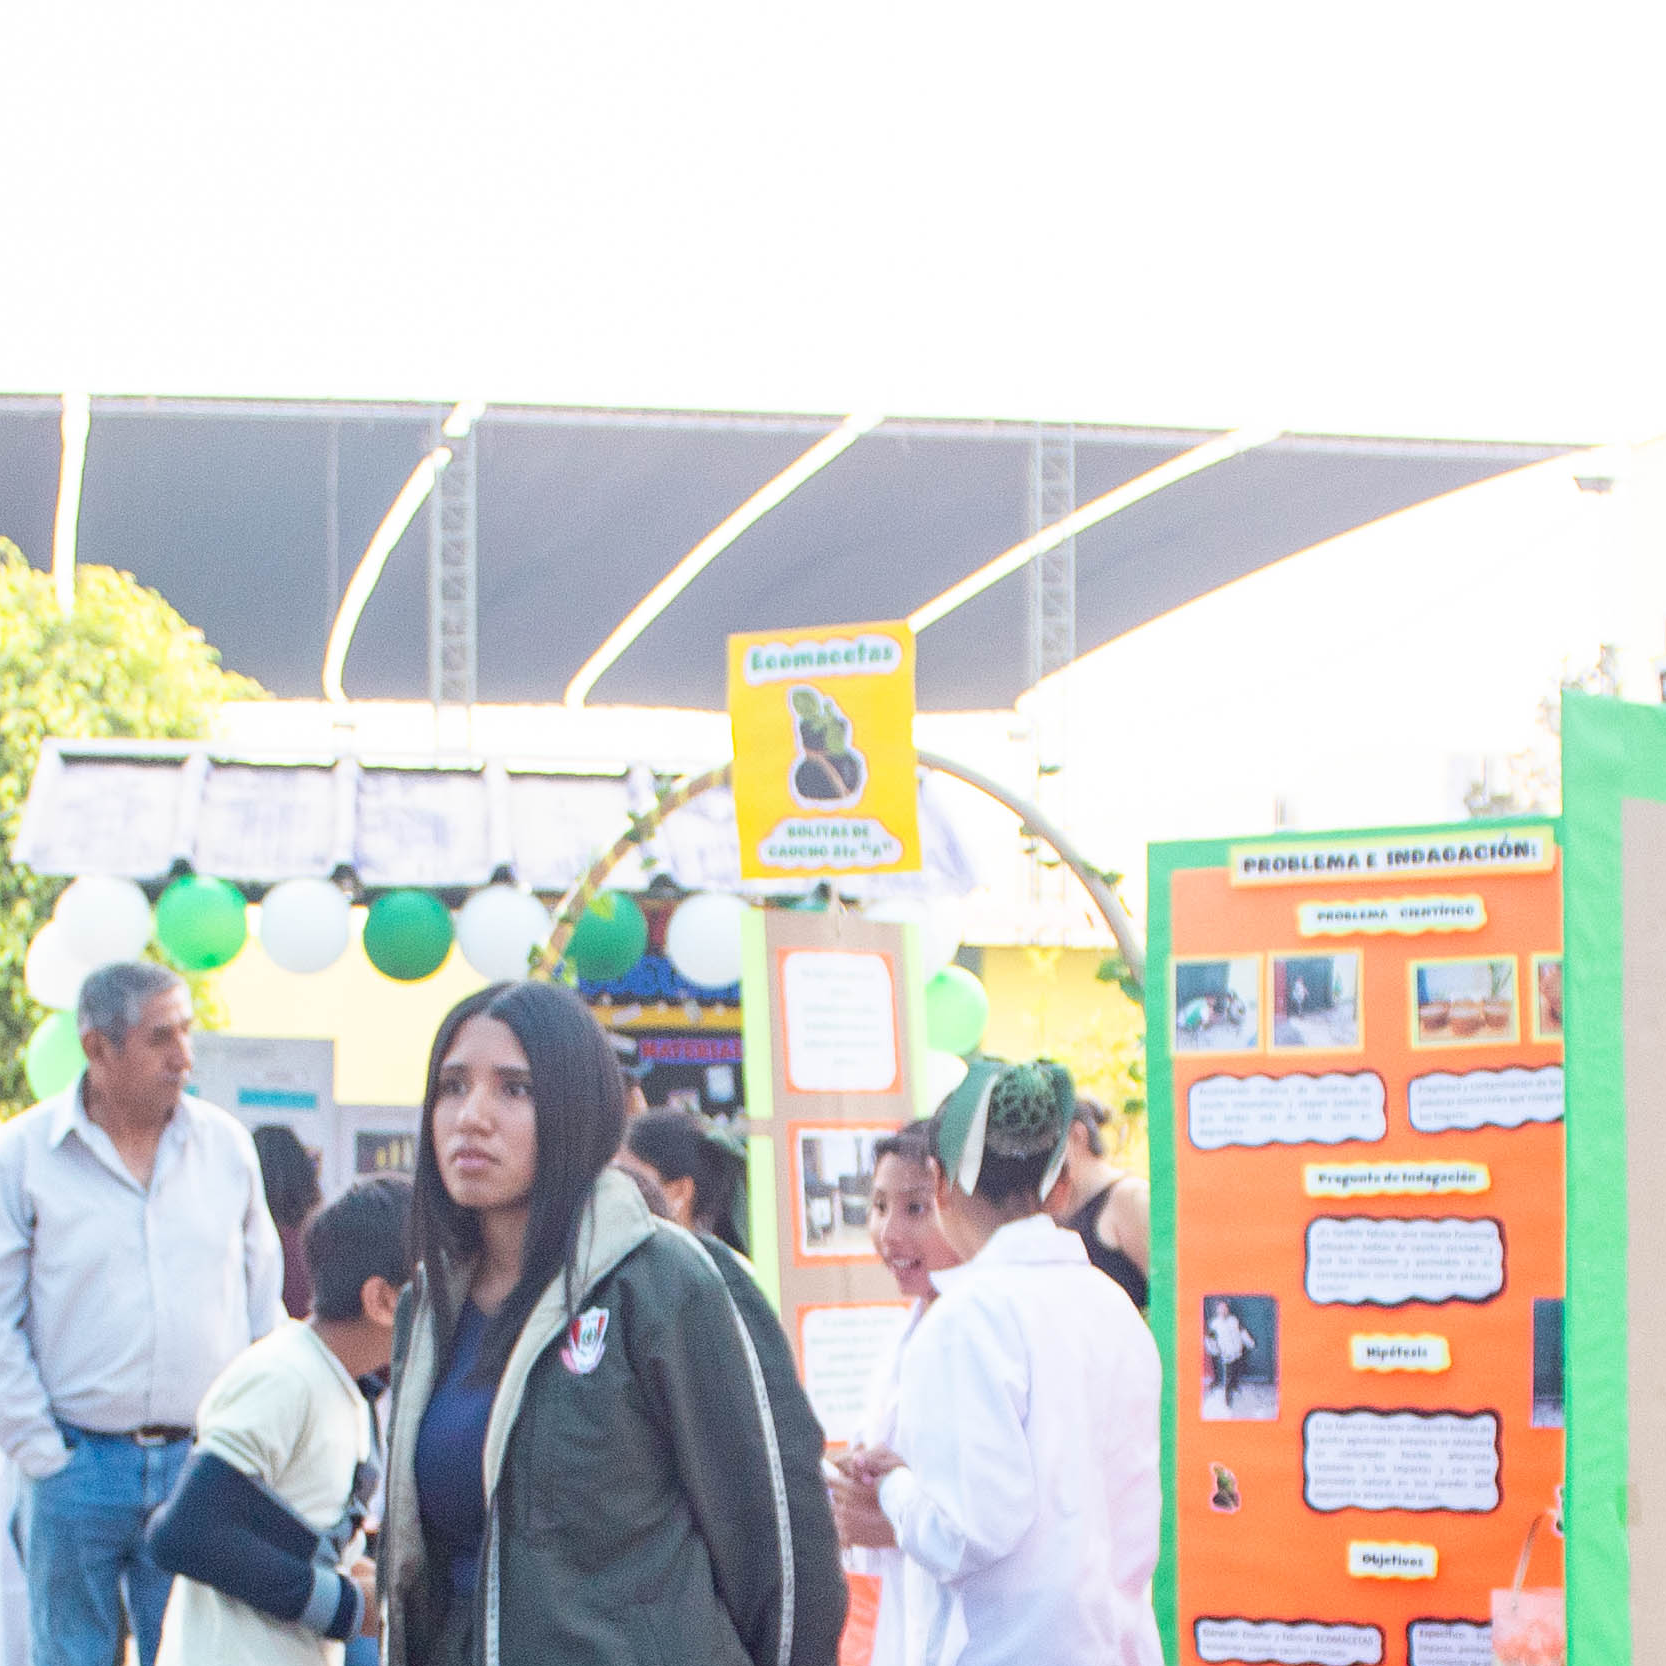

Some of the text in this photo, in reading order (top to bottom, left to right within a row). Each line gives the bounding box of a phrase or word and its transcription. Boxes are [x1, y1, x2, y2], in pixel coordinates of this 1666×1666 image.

[751, 644, 893, 670] Ecomacetas
[1243, 834, 1537, 873] PROBLEMA E INDAGACIÓN:
[1363, 1554, 1423, 1567] Objetivos
